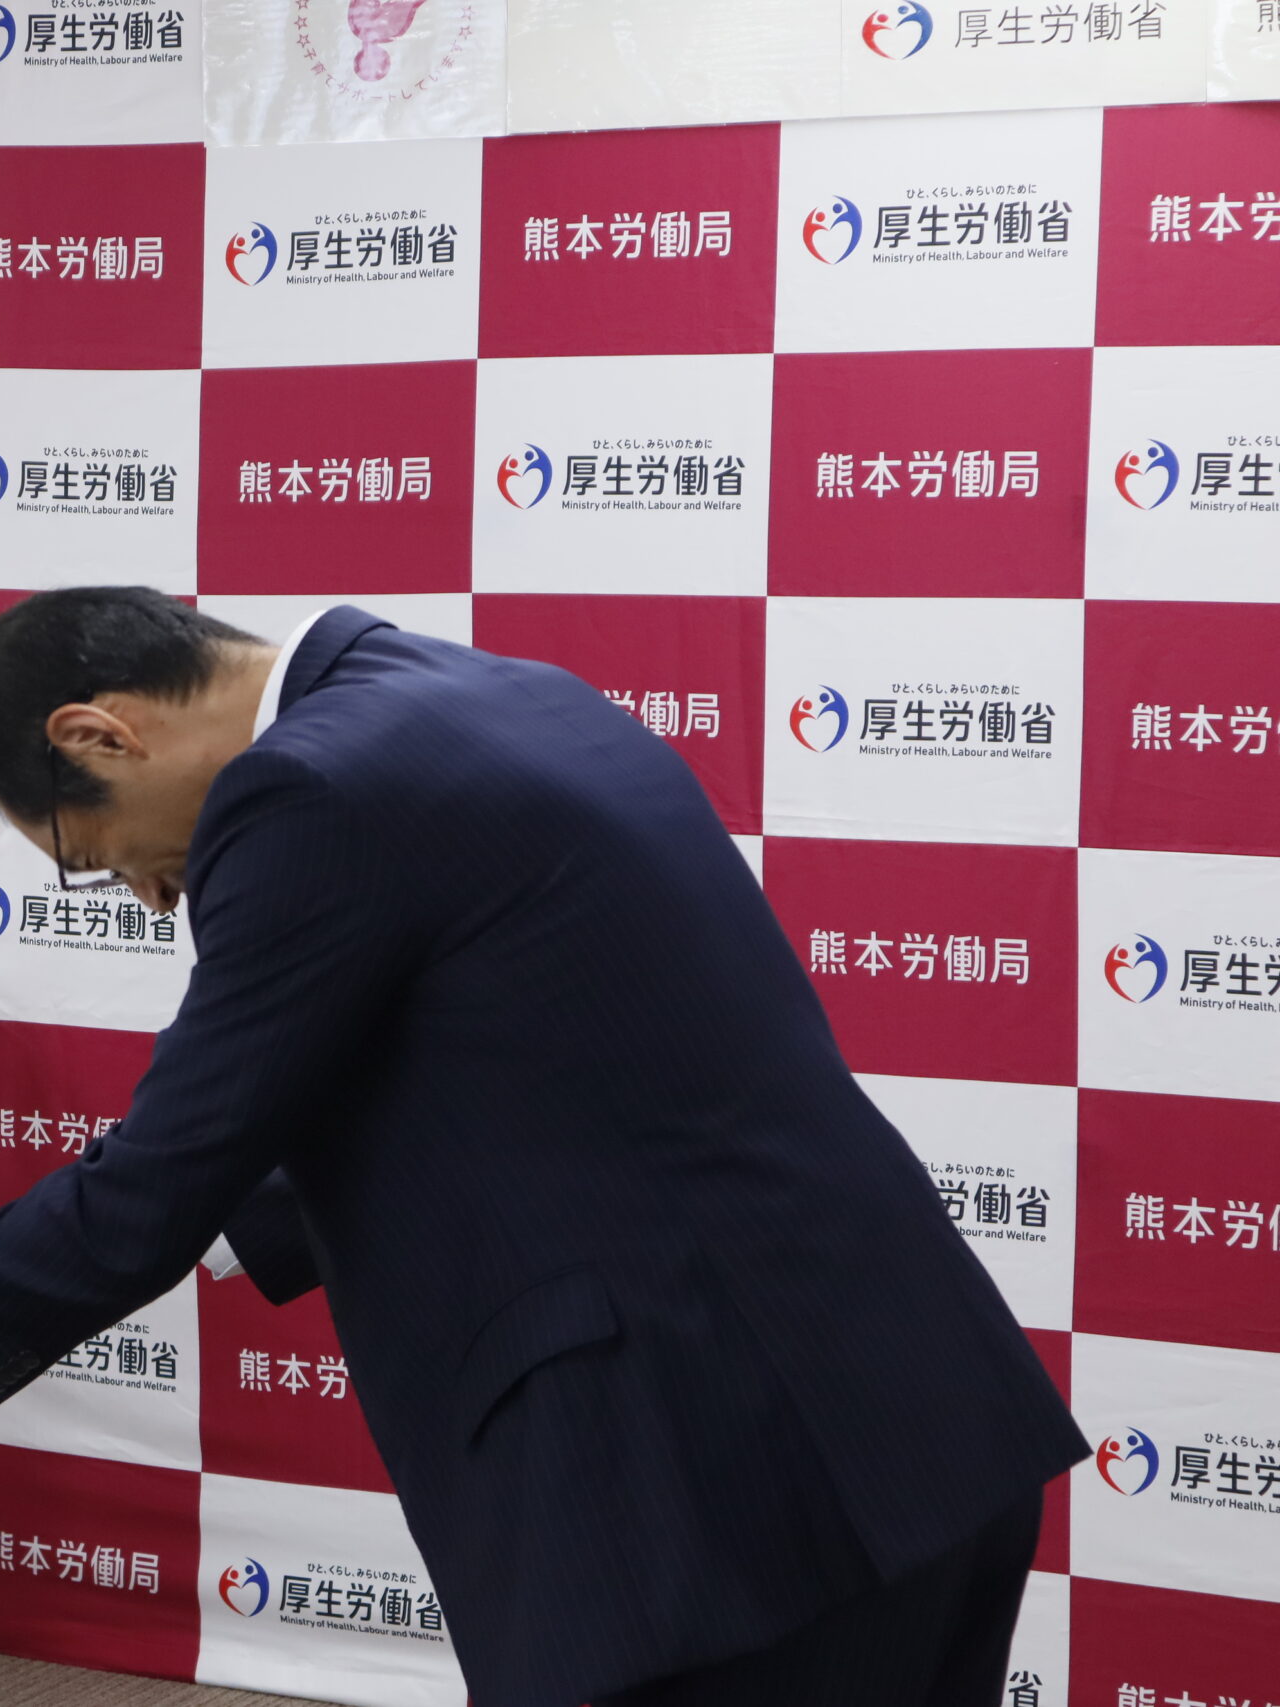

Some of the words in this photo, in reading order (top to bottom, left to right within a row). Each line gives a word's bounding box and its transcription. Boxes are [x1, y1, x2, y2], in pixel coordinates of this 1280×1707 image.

[25, 10, 184, 52] 厚生労働省
[955, 0, 1167, 48] 厚生労働省
[24, 57, 58, 67] Ministry
[60, 57, 67, 65] of
[70, 56, 99, 65] Health,
[100, 56, 130, 64] Labour
[132, 55, 147, 63] and
[149, 53, 182, 62] Welfare
[906, 183, 1038, 199] ひと、くらし、みらいのために
[315, 209, 427, 225] ひと、くらし、みらいのために
[872, 199, 1073, 249] 厚生労働省
[524, 210, 732, 261] 熊本労働局
[286, 223, 458, 270] 厚生労働省
[873, 254, 914, 263] Ministry
[916, 252, 925, 261] of
[929, 251, 964, 261] Health,
[967, 251, 1003, 260] Labour
[1005, 249, 1024, 258] and
[1028, 248, 1068, 257] Welfare
[287, 275, 322, 285] Ministry
[324, 274, 333, 283] of
[335, 273, 365, 282] Health,
[367, 272, 398, 281] Labour
[400, 270, 416, 279] and
[419, 268, 454, 278] Welfare
[43, 447, 149, 458] ひと、くらし、みらいのために
[593, 438, 713, 450] ひと、くらし、みらいのために
[17, 461, 177, 502] 厚生労働省
[239, 457, 432, 503] 熊本労働局
[562, 450, 745, 497] 厚生労働省
[816, 450, 1040, 499] 熊本労働局
[1191, 452, 1280, 496] 厚生
[17, 503, 50, 514] Ministry
[51, 504, 59, 512] of
[61, 504, 90, 514] Health,
[93, 505, 122, 514] Labour
[124, 506, 139, 515] and
[141, 507, 174, 515] Welfare
[562, 501, 600, 511] Ministry
[602, 501, 610, 509] of
[613, 501, 646, 511] Health,
[648, 501, 681, 509] Labour
[684, 501, 701, 510] and
[704, 501, 741, 510] Welfare
[1191, 501, 1234, 512] Ministry
[1237, 502, 1247, 511] of
[892, 682, 1020, 696] ひと、くらし、みらいのために
[859, 700, 1057, 744] 厚生労働省
[1131, 702, 1280, 755] 熊本労
[860, 745, 900, 756] Ministry
[902, 746, 911, 755] of
[914, 746, 949, 757] Health,
[952, 747, 987, 757] Labour
[990, 748, 1008, 757] and
[1012, 749, 1052, 759] Welfare
[19, 896, 177, 942] 厚生労働省
[20, 936, 52, 948] Ministry
[53, 939, 61, 947] of
[64, 940, 92, 950] Health,
[94, 942, 124, 952] Labour
[125, 945, 140, 953] and
[142, 946, 175, 955] Welfare
[810, 929, 1030, 985] 熊本労働局
[1180, 997, 1223, 1010] Ministry
[1225, 1000, 1236, 1009] of
[1239, 1000, 1276, 1012] Health,
[1125, 1192, 1280, 1252] 熊本労
[958, 1227, 982, 1237] bour
[985, 1229, 1003, 1239] and
[1007, 1230, 1047, 1242] Welfare
[110, 1322, 150, 1334] のために
[66, 1371, 94, 1383] Health,
[95, 1376, 124, 1386] Labour
[126, 1380, 141, 1389] and
[144, 1381, 177, 1392] Welfare
[1204, 1433, 1280, 1451] ひと、くらし、み
[1171, 1492, 1214, 1508] Ministry
[1216, 1496, 1226, 1507] of
[1229, 1496, 1267, 1512] Health,
[307, 1563, 417, 1584] ひと、くらし、みらいのために
[279, 1575, 442, 1631] 厚生労働省
[280, 1615, 315, 1628] Ministry
[359, 1625, 389, 1635] Labour
[409, 1631, 444, 1642] Welfare
